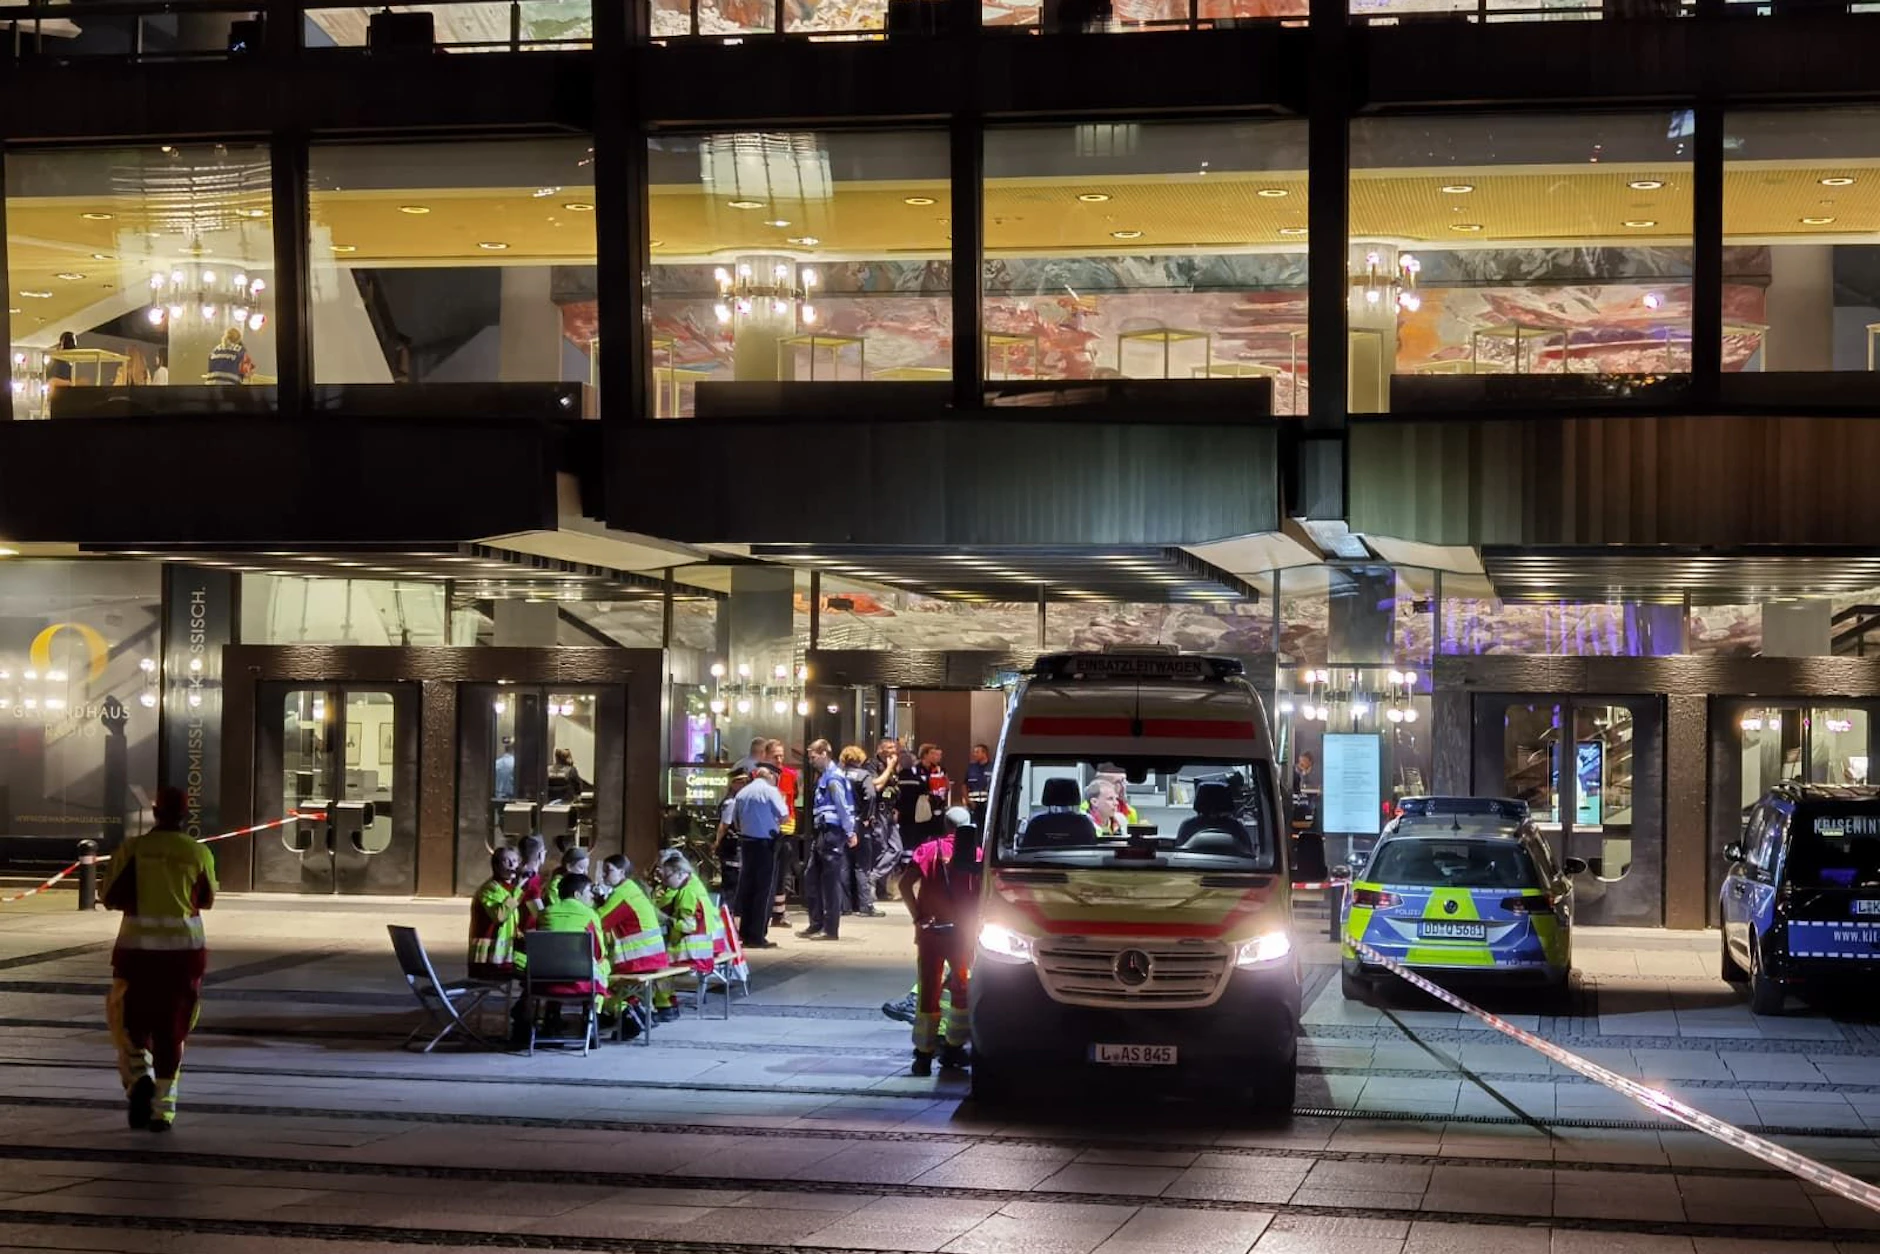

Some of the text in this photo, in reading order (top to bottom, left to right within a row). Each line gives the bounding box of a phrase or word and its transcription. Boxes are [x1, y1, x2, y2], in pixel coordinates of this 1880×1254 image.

[1077, 659, 1202, 673] EINSATZLEITWAGEN
[1425, 922, 1438, 935] DD
[1456, 923, 1484, 937] 5681
[1121, 1046, 1141, 1061] AS
[1143, 1047, 1172, 1062] 845
